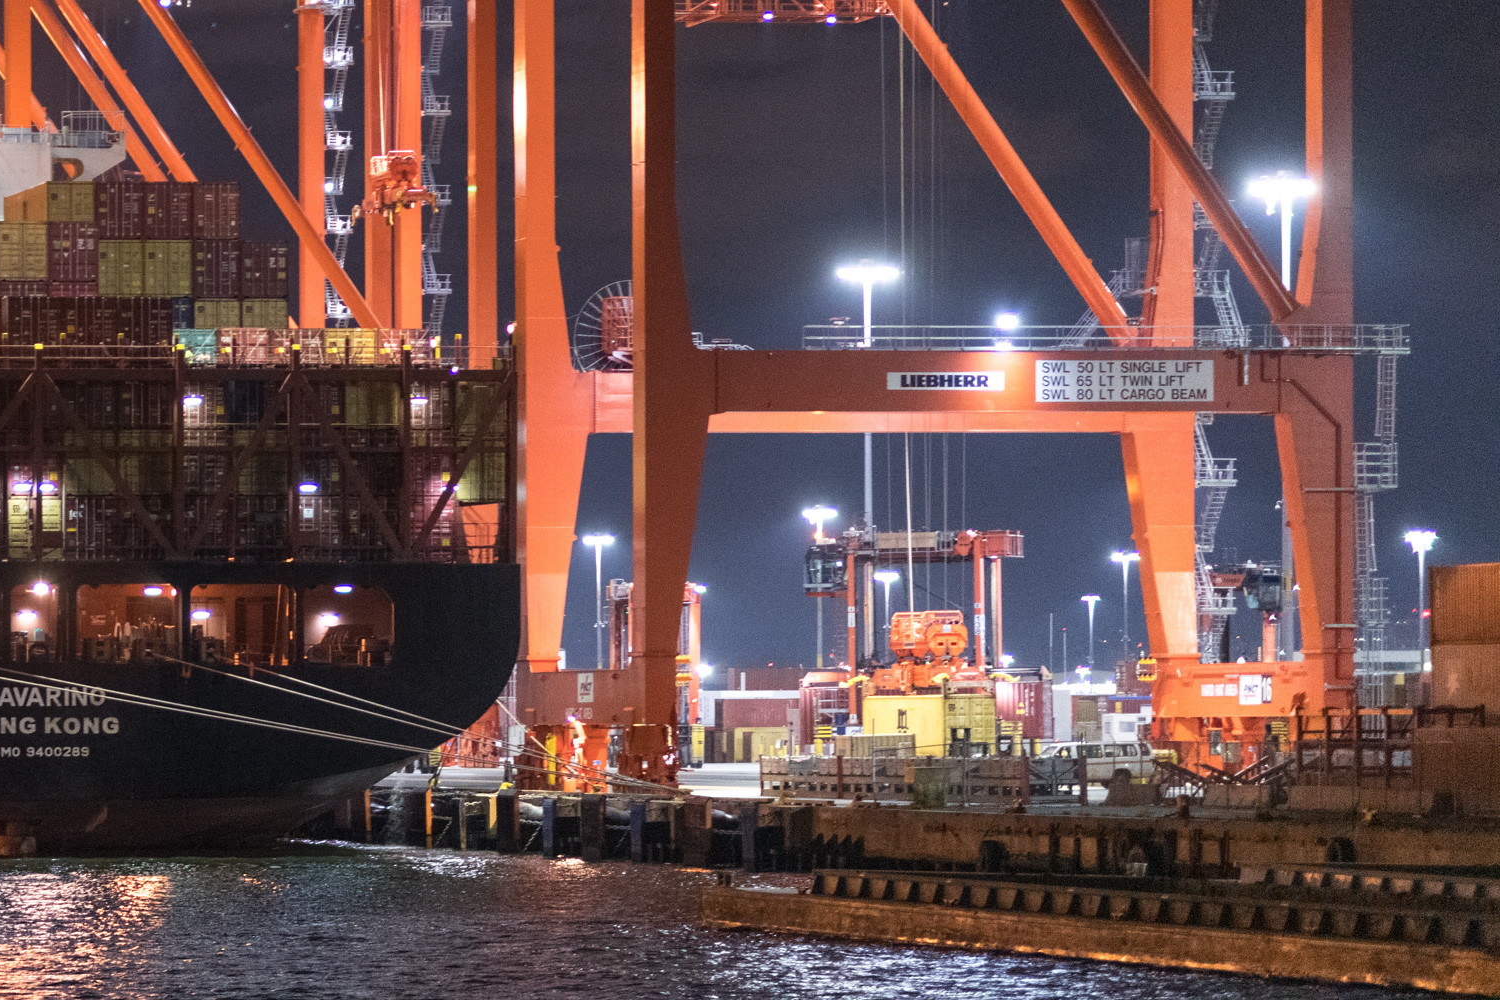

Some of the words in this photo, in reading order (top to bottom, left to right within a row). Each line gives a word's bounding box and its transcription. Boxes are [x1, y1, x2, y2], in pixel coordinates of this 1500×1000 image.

[1042, 362, 1070, 373] SWL
[1077, 362, 1094, 373] 50
[1099, 362, 1115, 373] LT
[1120, 362, 1166, 373] SINGLE
[1175, 362, 1202, 373] LIFT
[901, 375, 988, 387] LIEBHERR
[1042, 376, 1070, 386] SWL
[1077, 376, 1093, 386] 65
[1099, 376, 1115, 386] LT
[1120, 376, 1153, 386] TWIN
[1158, 376, 1185, 386] LIFT
[1042, 389, 1070, 400] SWL
[1077, 389, 1094, 400] 80
[1099, 389, 1115, 400] LT
[1120, 389, 1165, 400] CARGO
[1171, 389, 1208, 400] BEAM
[44, 717, 119, 735] KONG
[26, 747, 90, 757] 9400289
